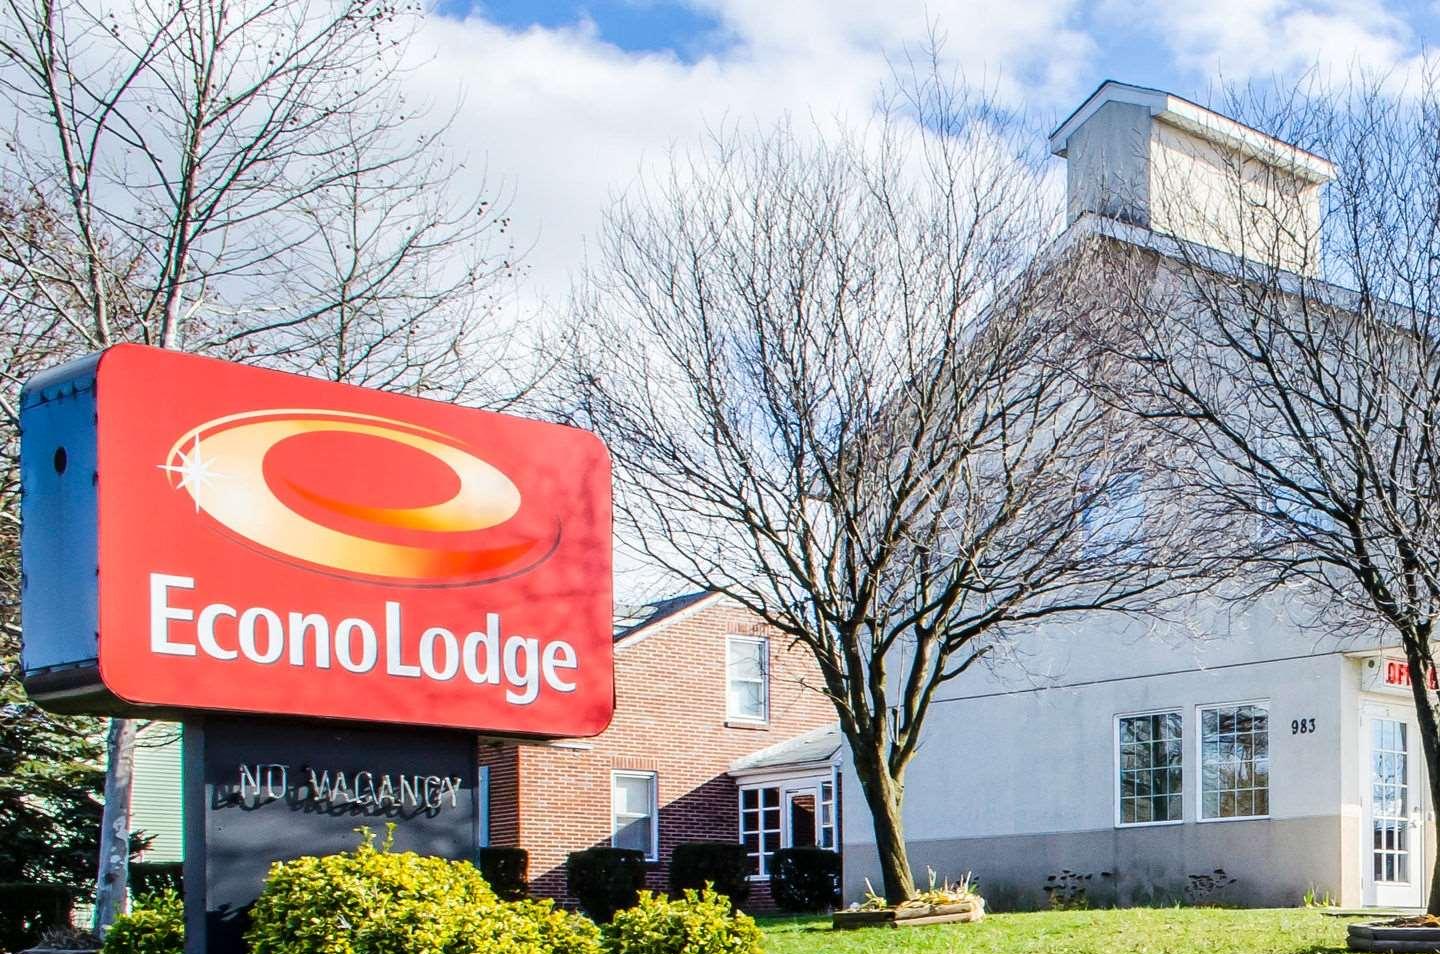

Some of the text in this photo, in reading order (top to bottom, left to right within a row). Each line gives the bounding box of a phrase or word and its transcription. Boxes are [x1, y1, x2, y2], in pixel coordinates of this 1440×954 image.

[1386, 662, 1440, 691] OFFE
[1291, 719, 1316, 734] 983
[239, 763, 462, 809] NO VACANCY
